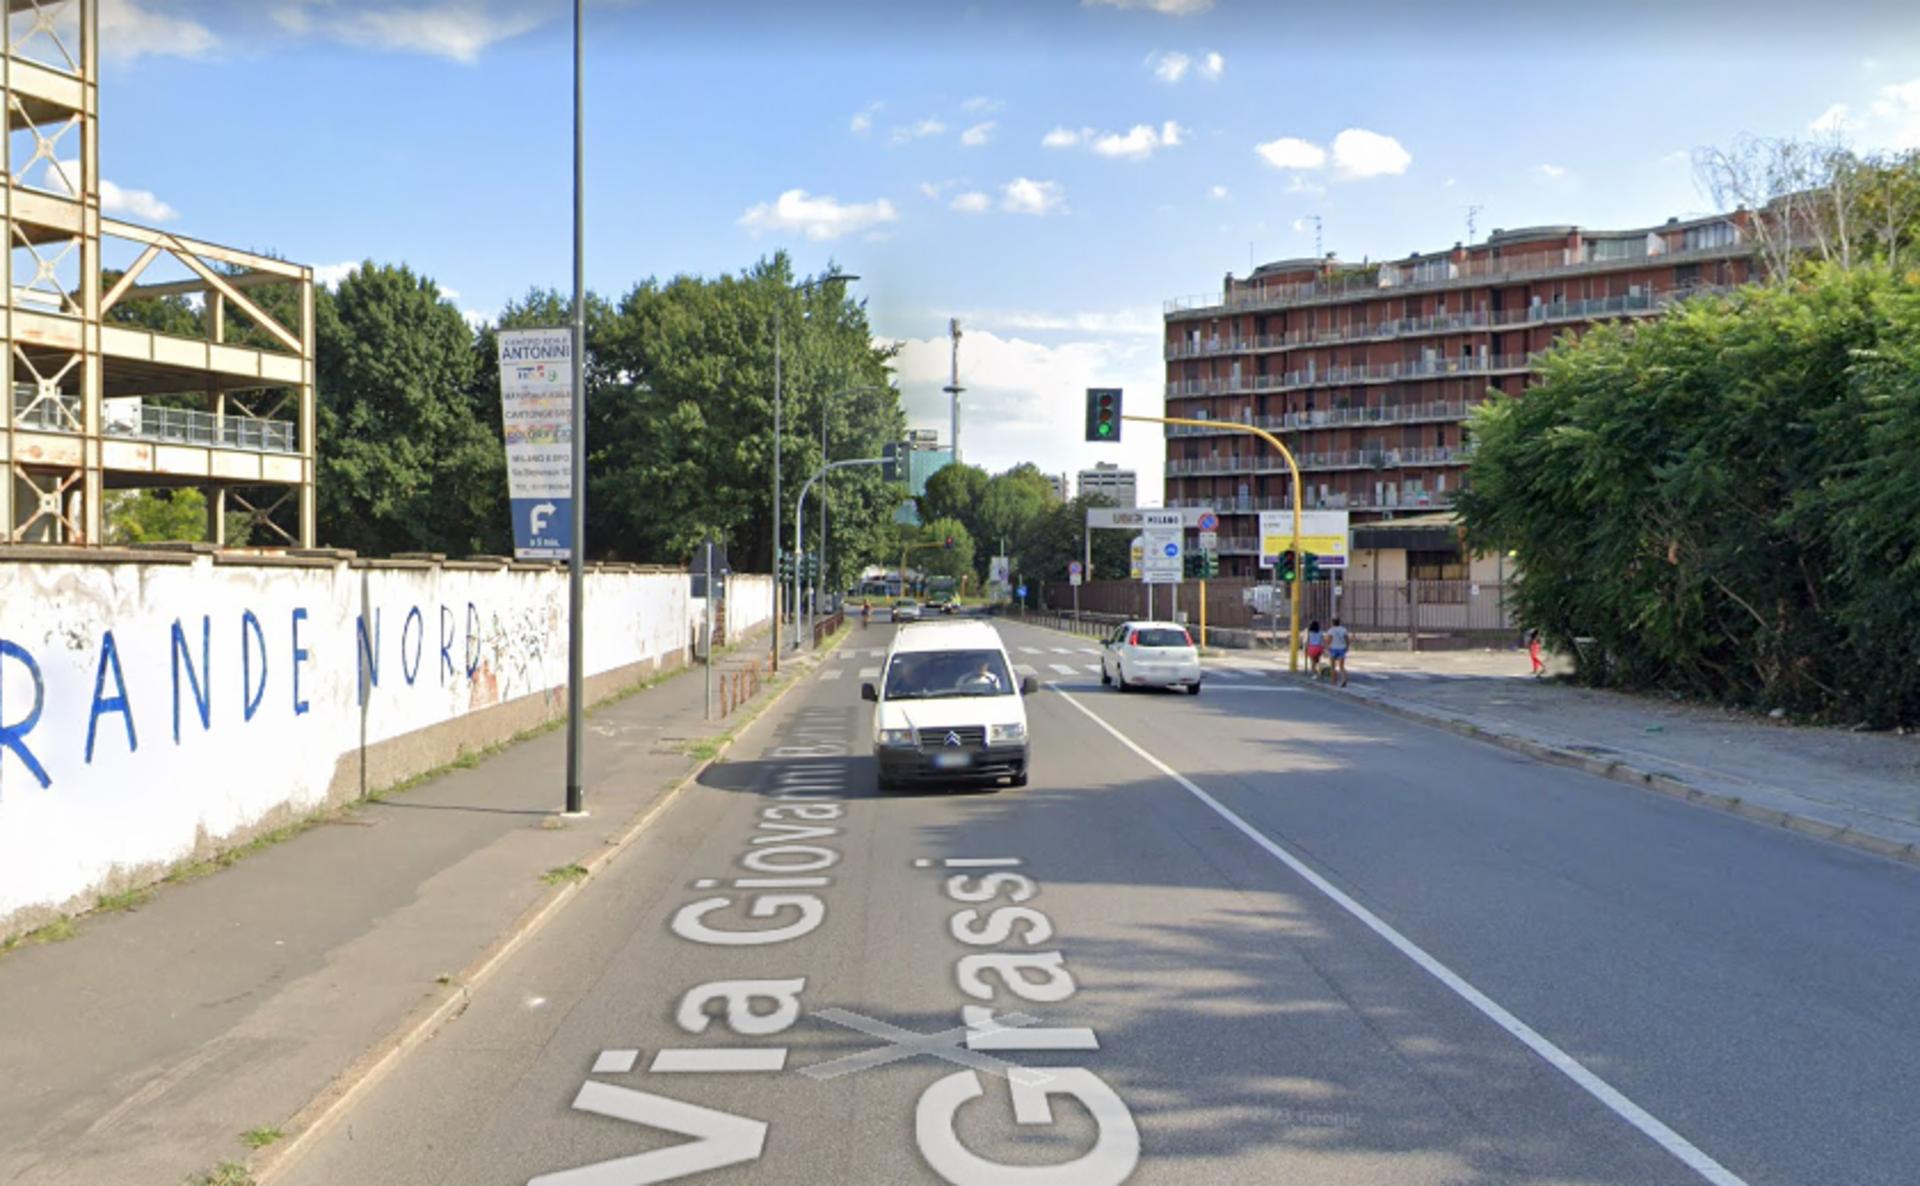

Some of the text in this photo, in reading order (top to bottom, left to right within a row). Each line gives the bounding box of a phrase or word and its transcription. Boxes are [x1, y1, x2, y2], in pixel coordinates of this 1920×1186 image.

[502, 345, 569, 360] ANTONINI
[1148, 516, 1179, 524] MILANO
[357, 600, 482, 706] NORD
